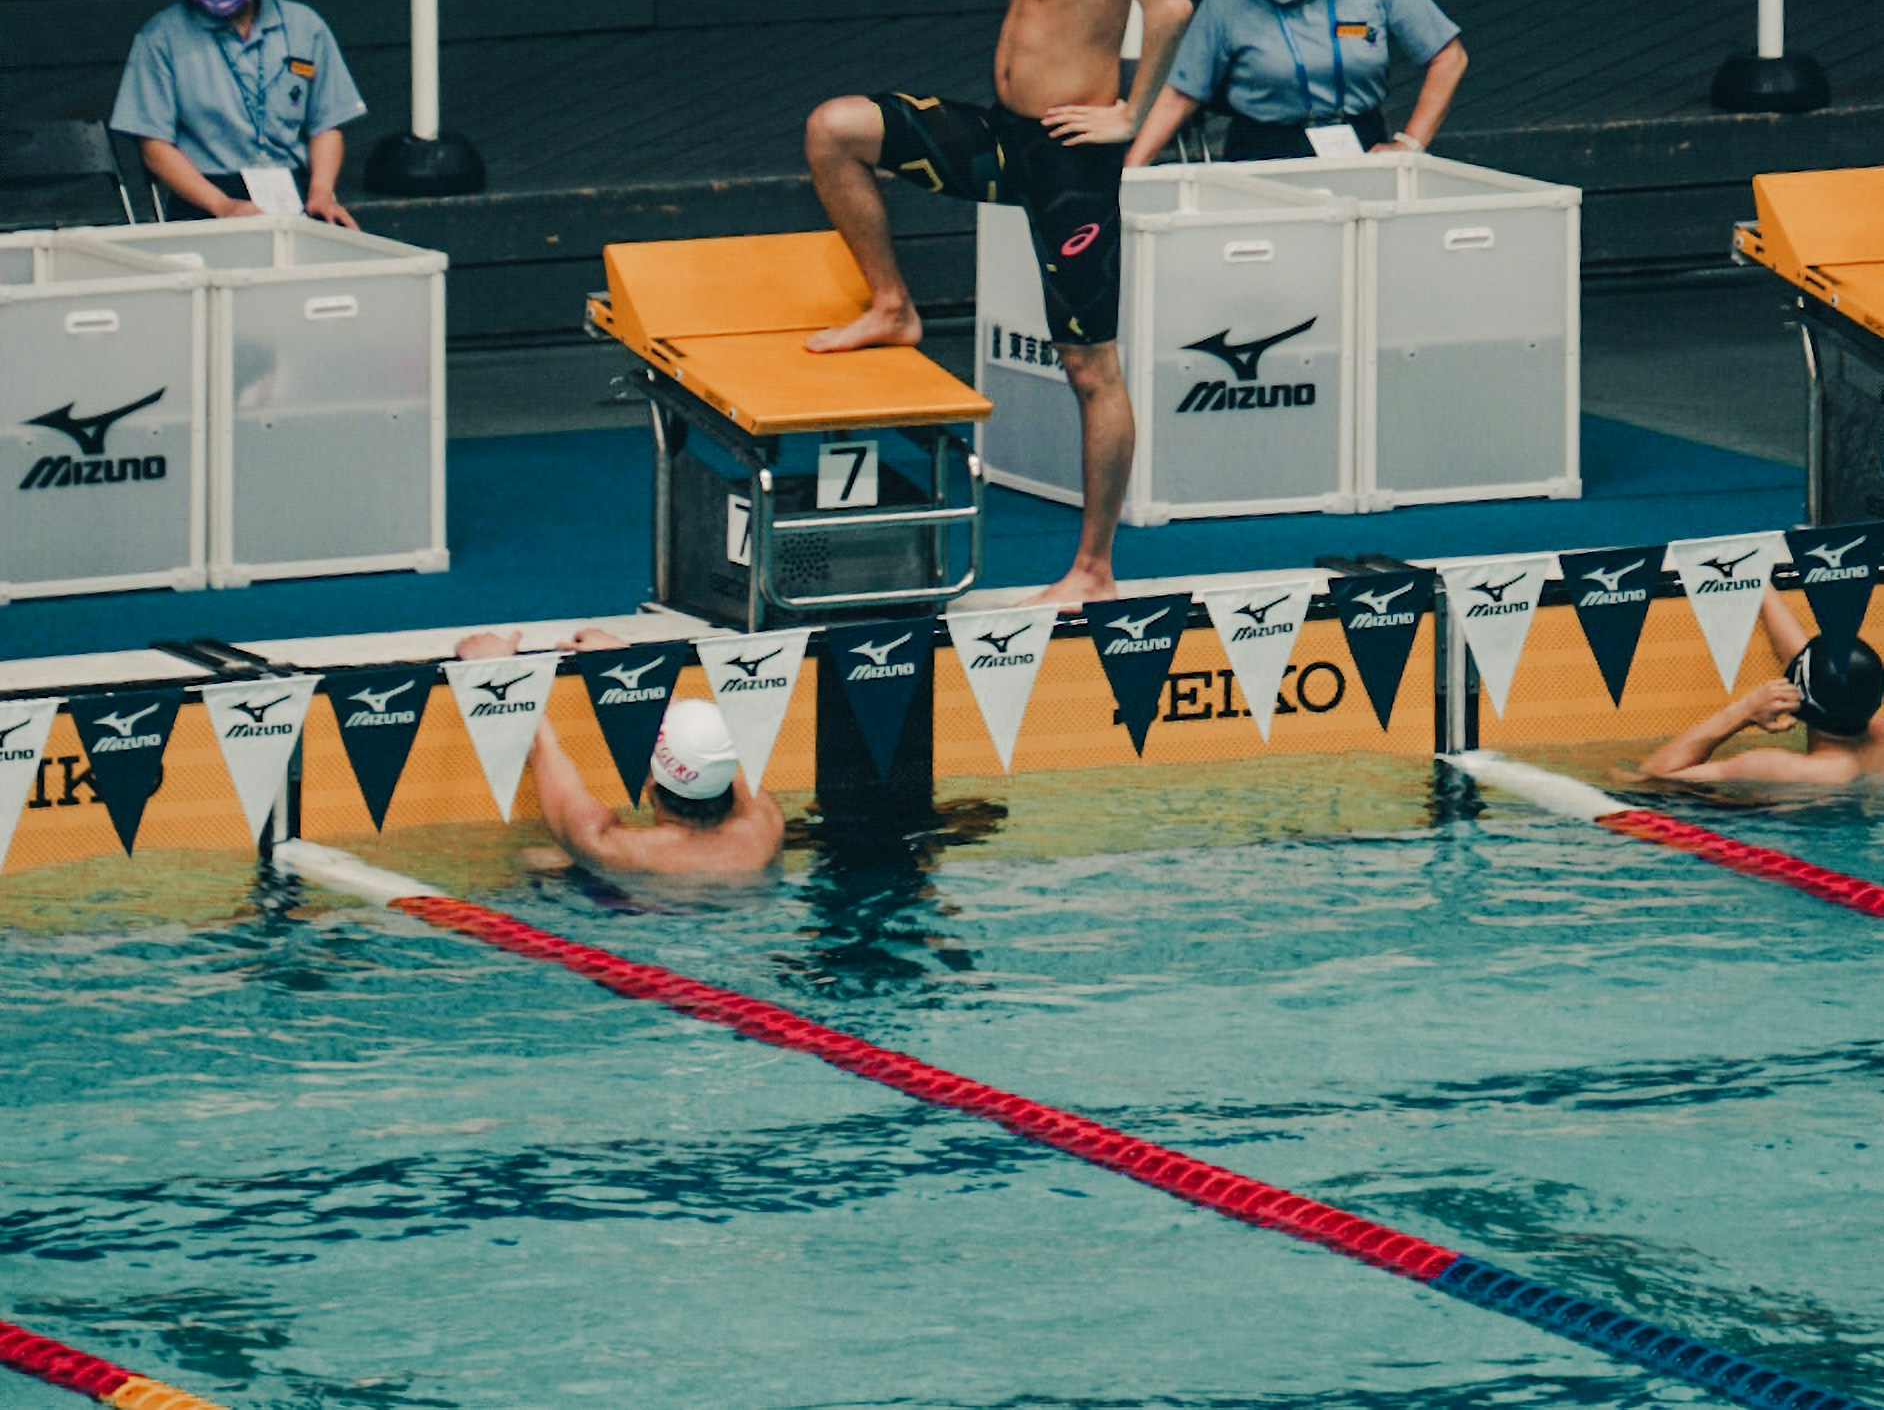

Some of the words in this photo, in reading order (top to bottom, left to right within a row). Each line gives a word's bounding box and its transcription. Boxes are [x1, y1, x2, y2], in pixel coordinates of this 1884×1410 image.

[1176, 381, 1316, 413] MIZUNO
[19, 455, 167, 489] MIZUNO
[830, 446, 867, 501] 7
[1804, 563, 1869, 582] MIZUNO
[1696, 577, 1762, 594] MIZUNO
[1579, 588, 1647, 608] MIZUNO
[1466, 600, 1530, 617] MIZUNO
[1348, 611, 1415, 630] MIZUNO
[1231, 622, 1294, 642] MIZUNO
[1103, 636, 1172, 655] MIZUNO
[970, 652, 1035, 669] MIZUNO
[847, 662, 915, 681] MIZUNO
[719, 677, 788, 693] MIZUNO
[598, 686, 666, 705] MIZUNO
[468, 700, 537, 717] MIZUNO
[345, 709, 416, 728] MIZUNO
[226, 722, 293, 739] MIZUNO
[91, 733, 162, 754] MIZUNO
